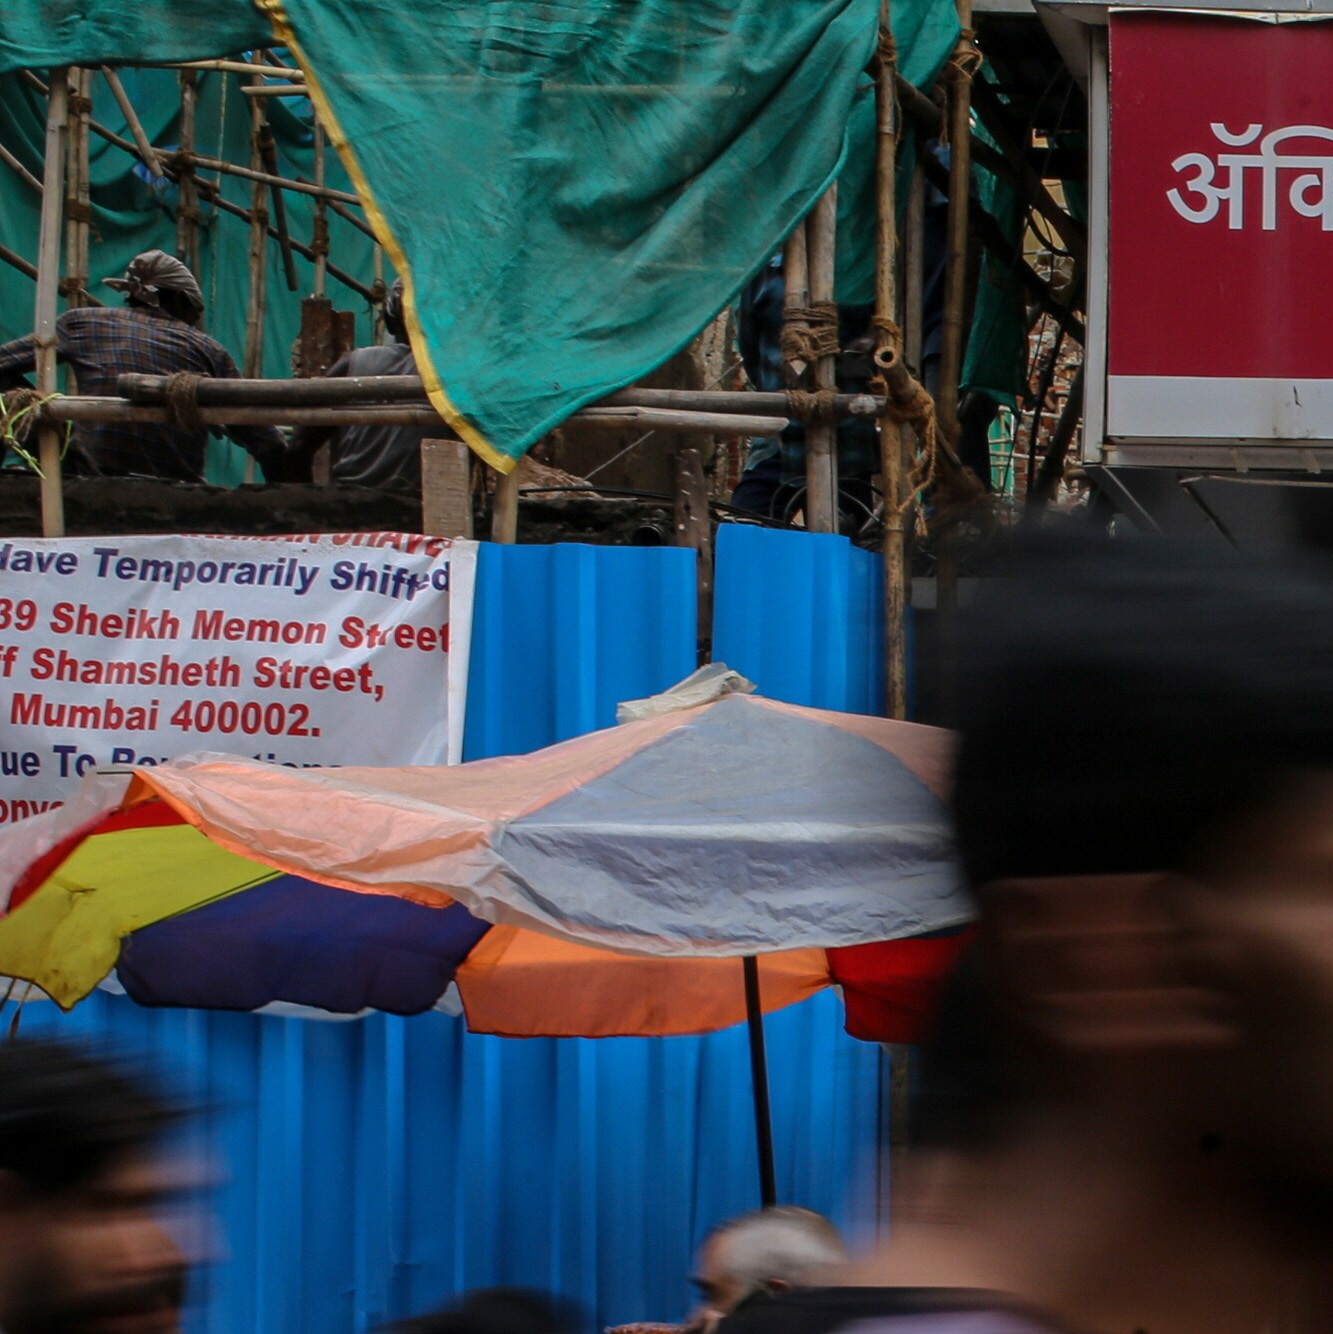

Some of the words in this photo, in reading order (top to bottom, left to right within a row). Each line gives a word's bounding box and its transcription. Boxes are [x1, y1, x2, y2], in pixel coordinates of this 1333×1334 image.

[93, 547, 319, 596] Temporarily
[50, 602, 180, 640] Sheikh
[191, 609, 327, 645] Memon
[339, 615, 450, 653] Street
[30, 647, 241, 687] Shamsheth
[253, 656, 385, 703] Street,
[10, 693, 160, 732] Mumbai
[170, 699, 321, 737] 400002.
[53, 744, 97, 778] To
